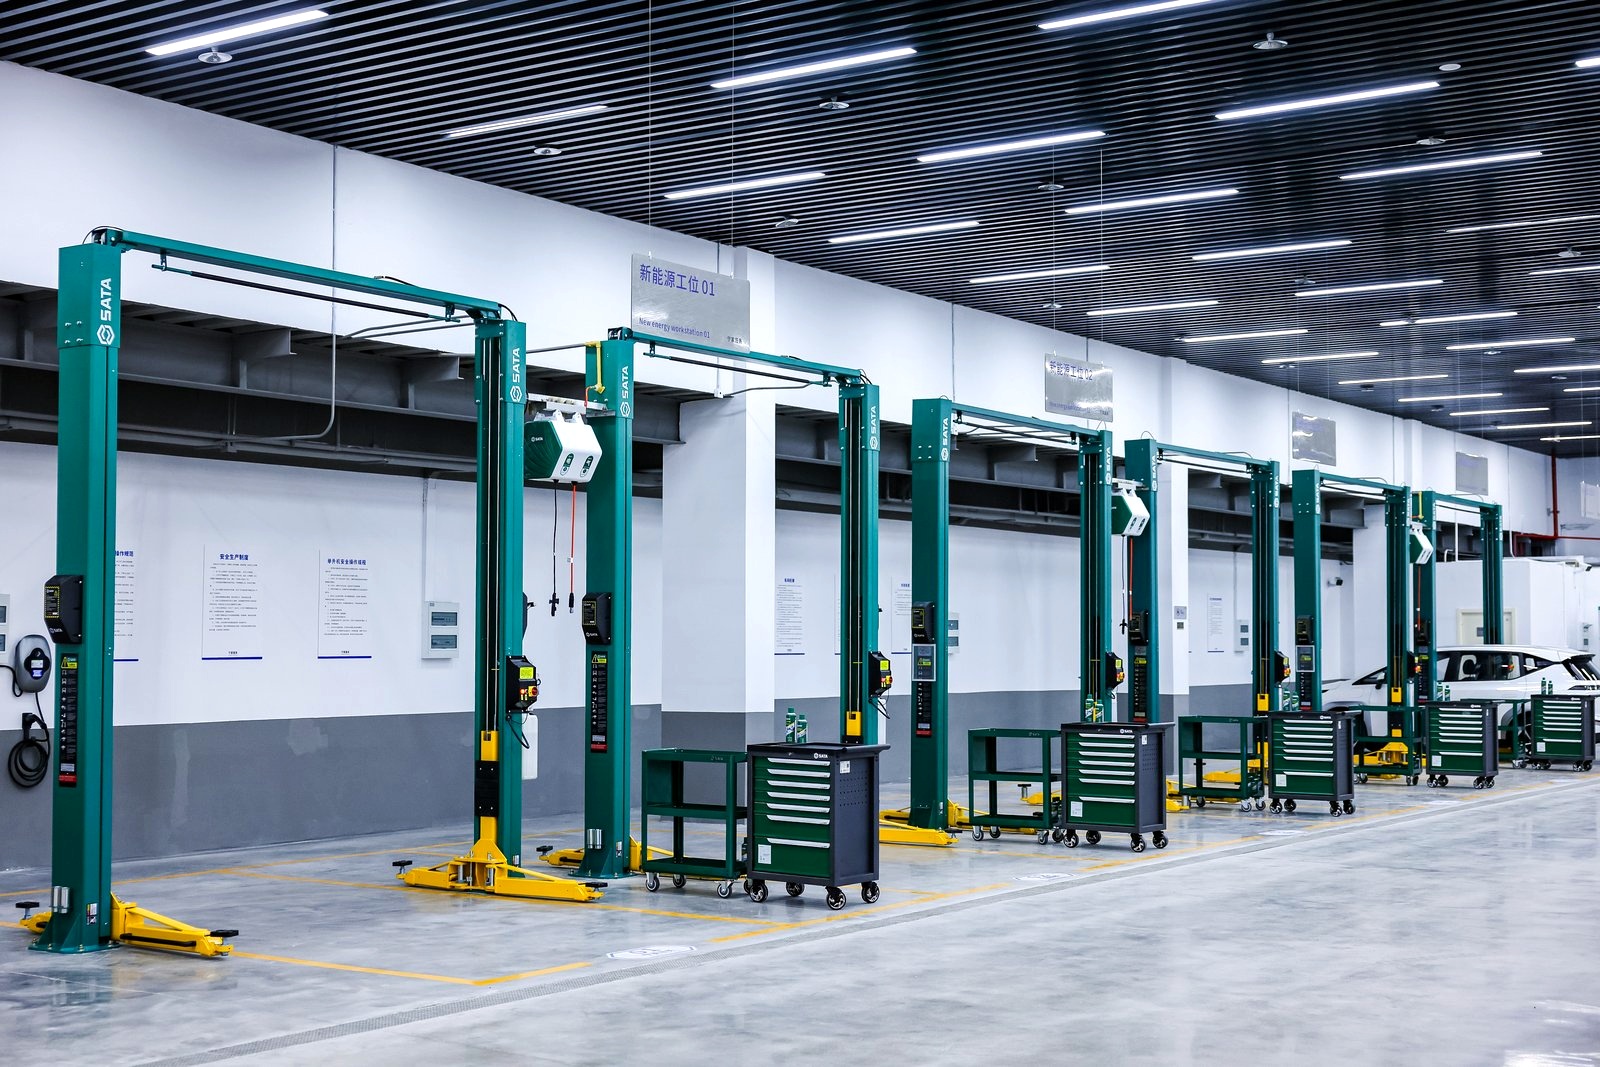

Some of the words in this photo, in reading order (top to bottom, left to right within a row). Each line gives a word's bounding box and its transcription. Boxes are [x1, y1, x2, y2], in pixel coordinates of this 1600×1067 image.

[640, 263, 699, 294] 新能源工位
[702, 280, 715, 296] 01
[100, 277, 112, 322] SATA
[639, 318, 651, 327] New
[652, 320, 670, 332] energy
[671, 326, 703, 337] workstation
[703, 330, 710, 339] 01
[512, 347, 520, 383] SATA
[621, 365, 629, 399] SATA
